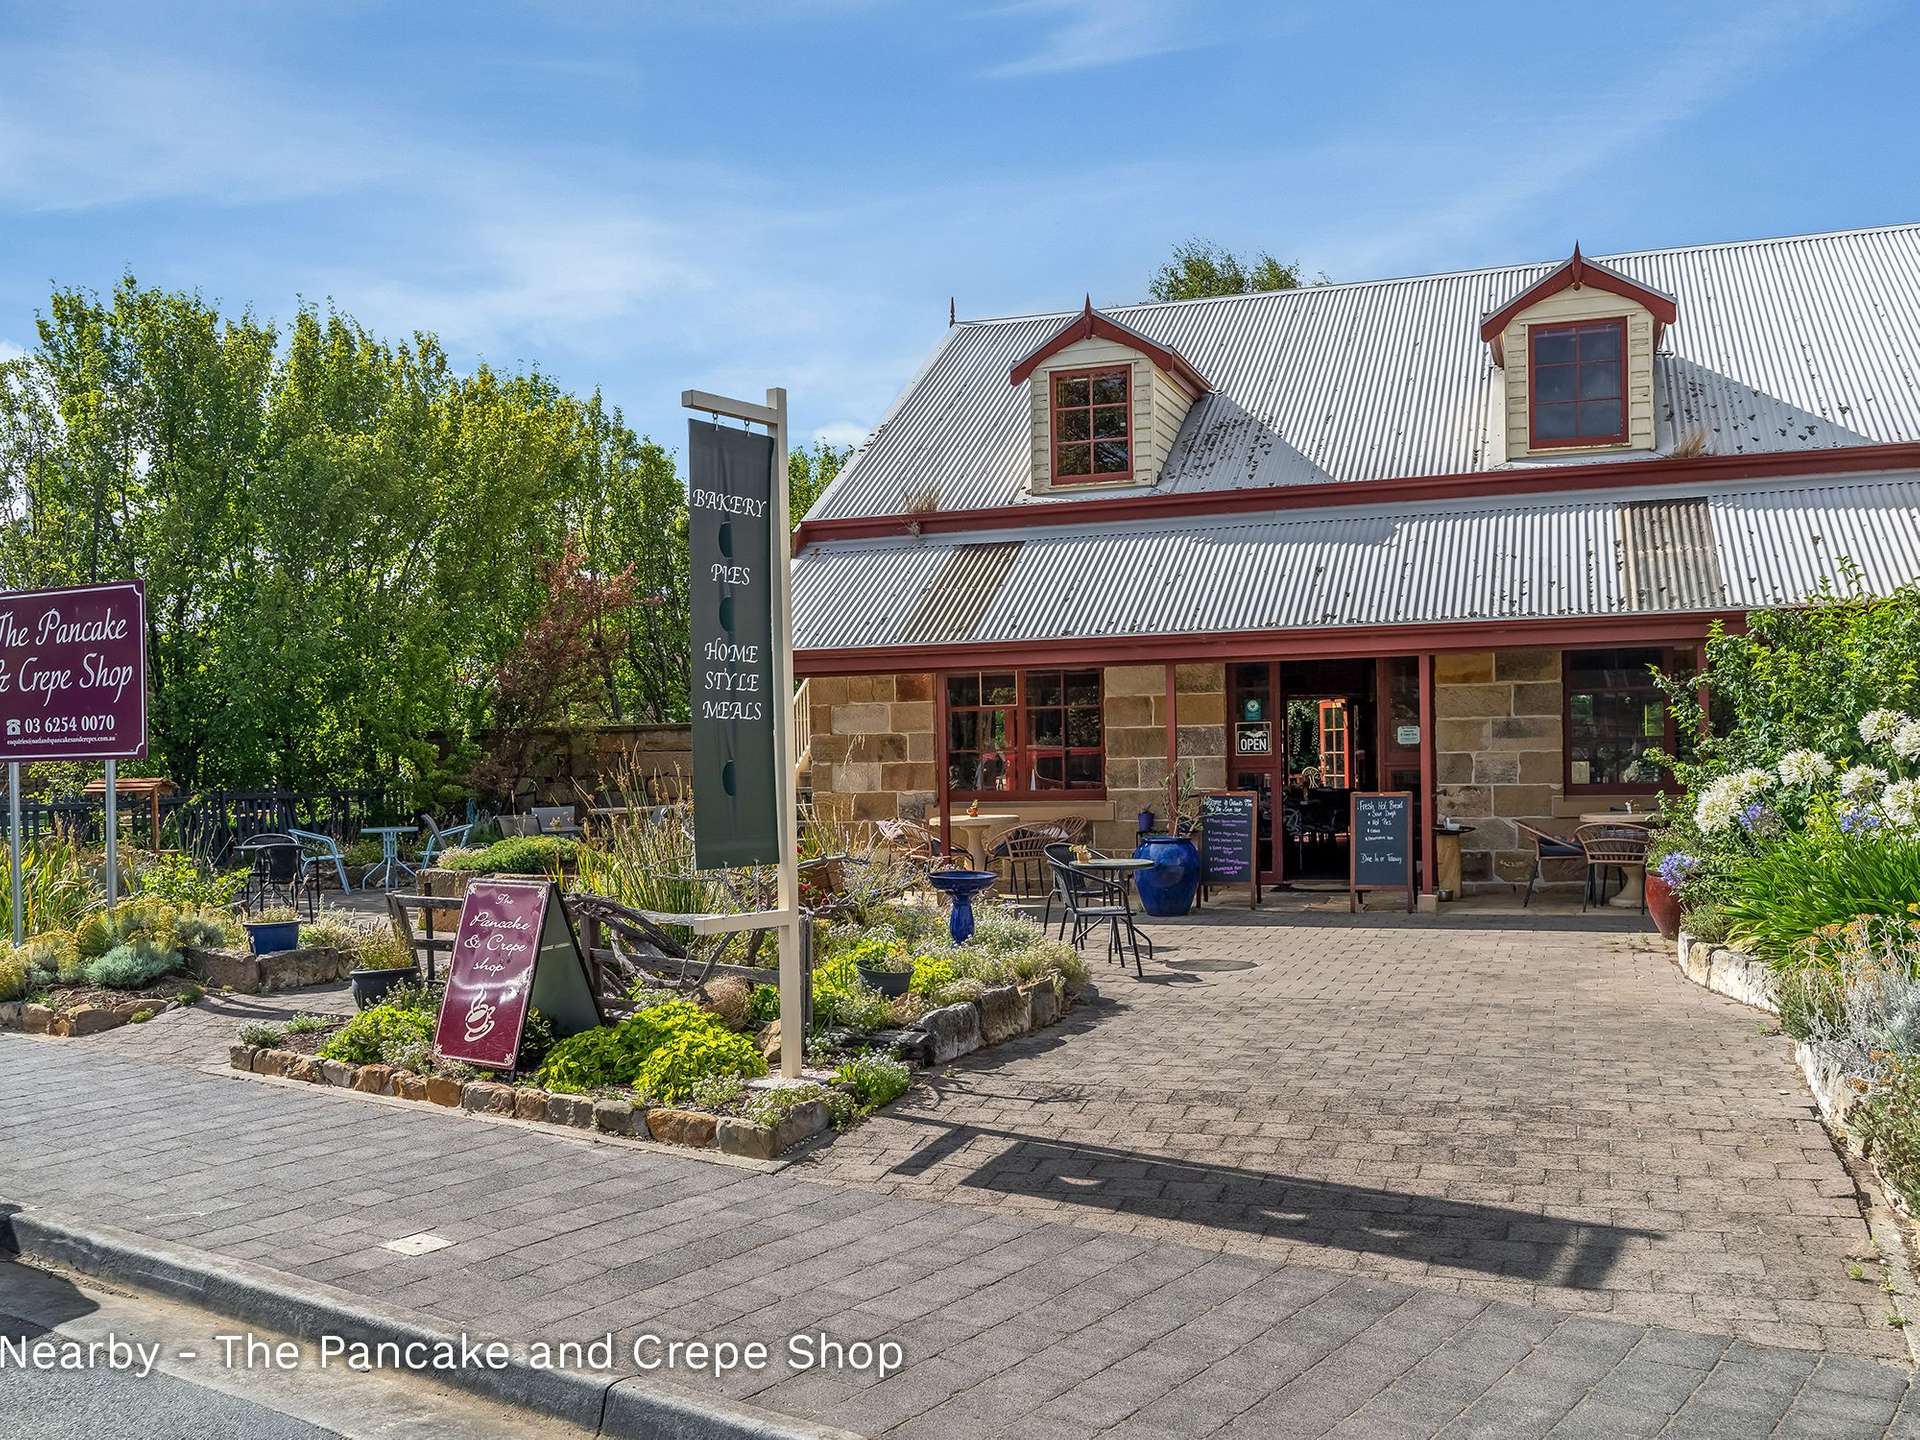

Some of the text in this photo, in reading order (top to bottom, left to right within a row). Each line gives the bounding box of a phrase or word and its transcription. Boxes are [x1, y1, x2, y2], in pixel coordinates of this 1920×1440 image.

[692, 488, 767, 518] BAKERY
[711, 563, 750, 586] PIES
[36, 607, 128, 646] Pancake
[704, 637, 759, 664] HOME
[18, 656, 73, 707] Crepe
[79, 652, 134, 703] Shop
[704, 667, 760, 692] STYLE
[702, 700, 762, 721] MEALS
[25, 714, 115, 734] 03 6254 0070
[1240, 738, 1267, 751] OPEN
[1359, 800, 1374, 811] Fresh
[495, 893, 514, 906] The
[469, 911, 530, 931] Pancake
[464, 934, 528, 957] & Crepe
[472, 956, 506, 977] shop
